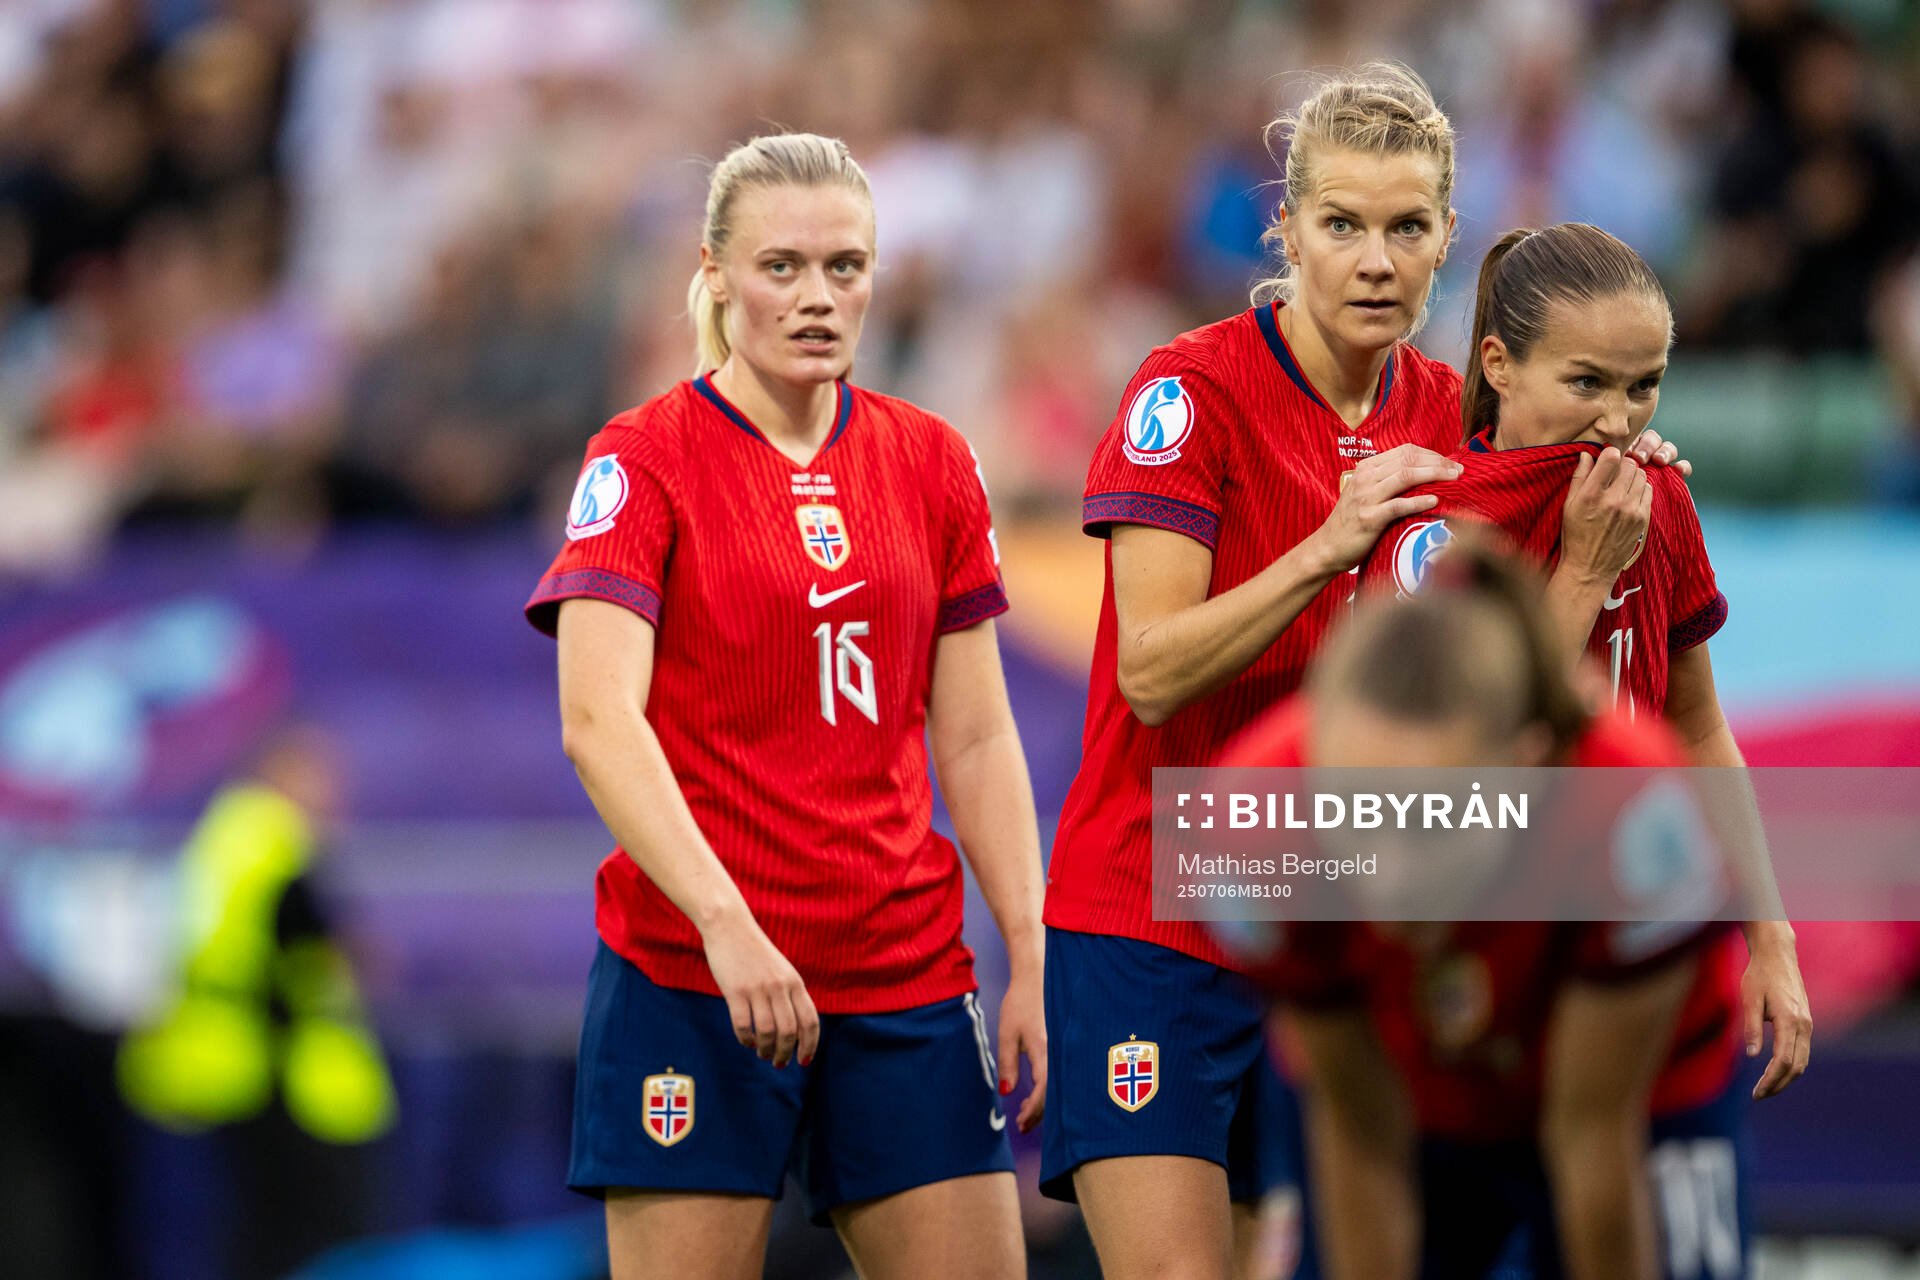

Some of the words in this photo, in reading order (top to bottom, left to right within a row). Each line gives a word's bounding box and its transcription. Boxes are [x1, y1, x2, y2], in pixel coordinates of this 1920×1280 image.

[1159, 449, 1178, 462] 2025
[1338, 436, 1356, 446] NOR
[813, 621, 879, 727] 16
[1606, 627, 1636, 726] 11
